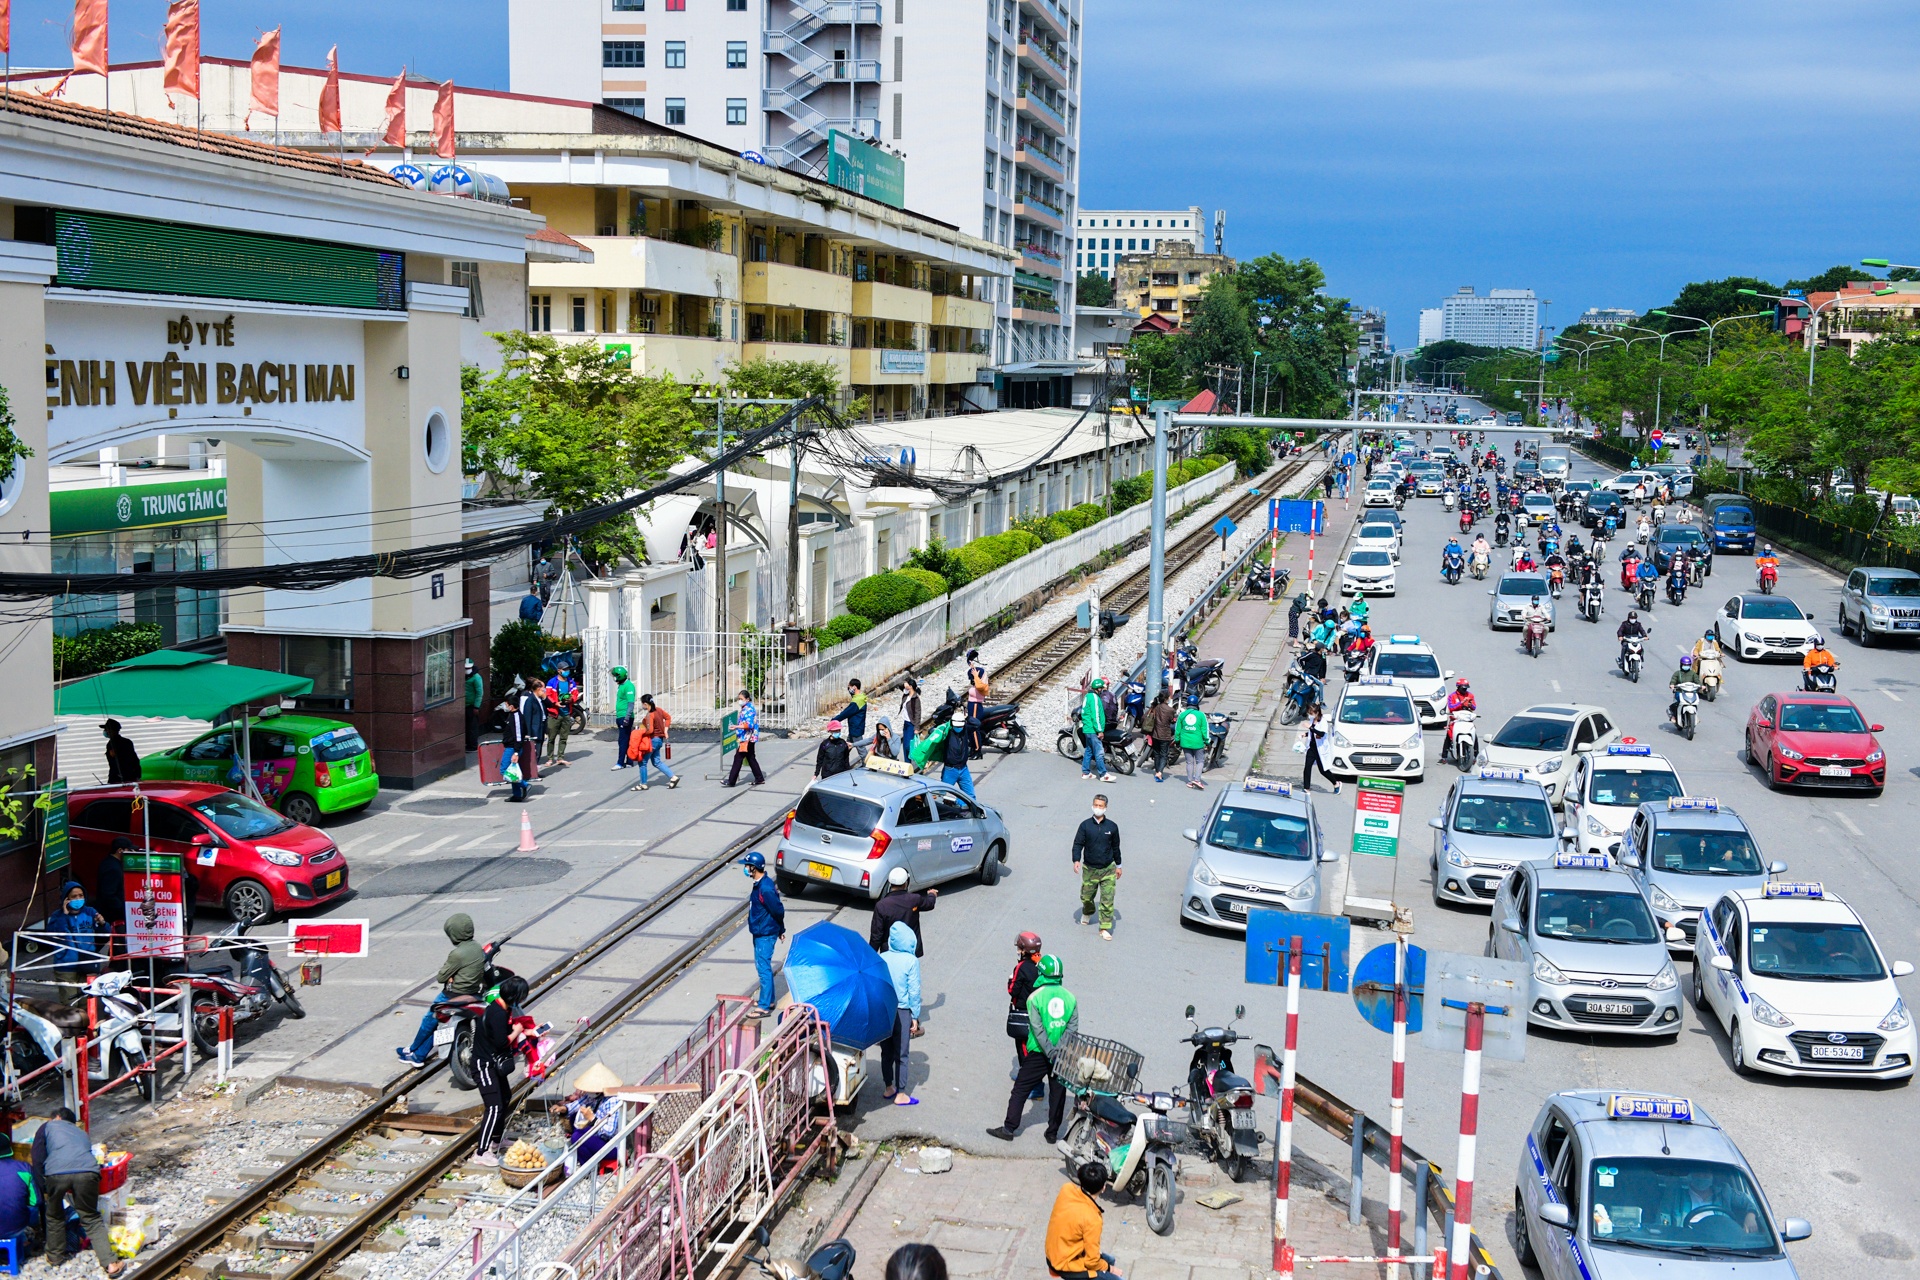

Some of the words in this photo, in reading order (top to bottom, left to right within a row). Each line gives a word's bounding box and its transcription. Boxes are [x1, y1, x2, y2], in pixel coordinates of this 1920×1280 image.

[168, 314, 193, 350] BỘ
[196, 323, 210, 346] Y
[213, 314, 235, 346] TẾ
[126, 351, 207, 419] VIỆN
[216, 360, 297, 416] BẠCH
[305, 364, 355, 402] MAI
[141, 493, 186, 516] TRUNG
[188, 488, 214, 511] TÂM
[1572, 857, 1581, 866] SAO
[1782, 885, 1795, 893] SAO
[156, 891, 172, 901] CHO
[1635, 1102, 1653, 1112] SAO
[1675, 1102, 1688, 1114] ĐÔ
